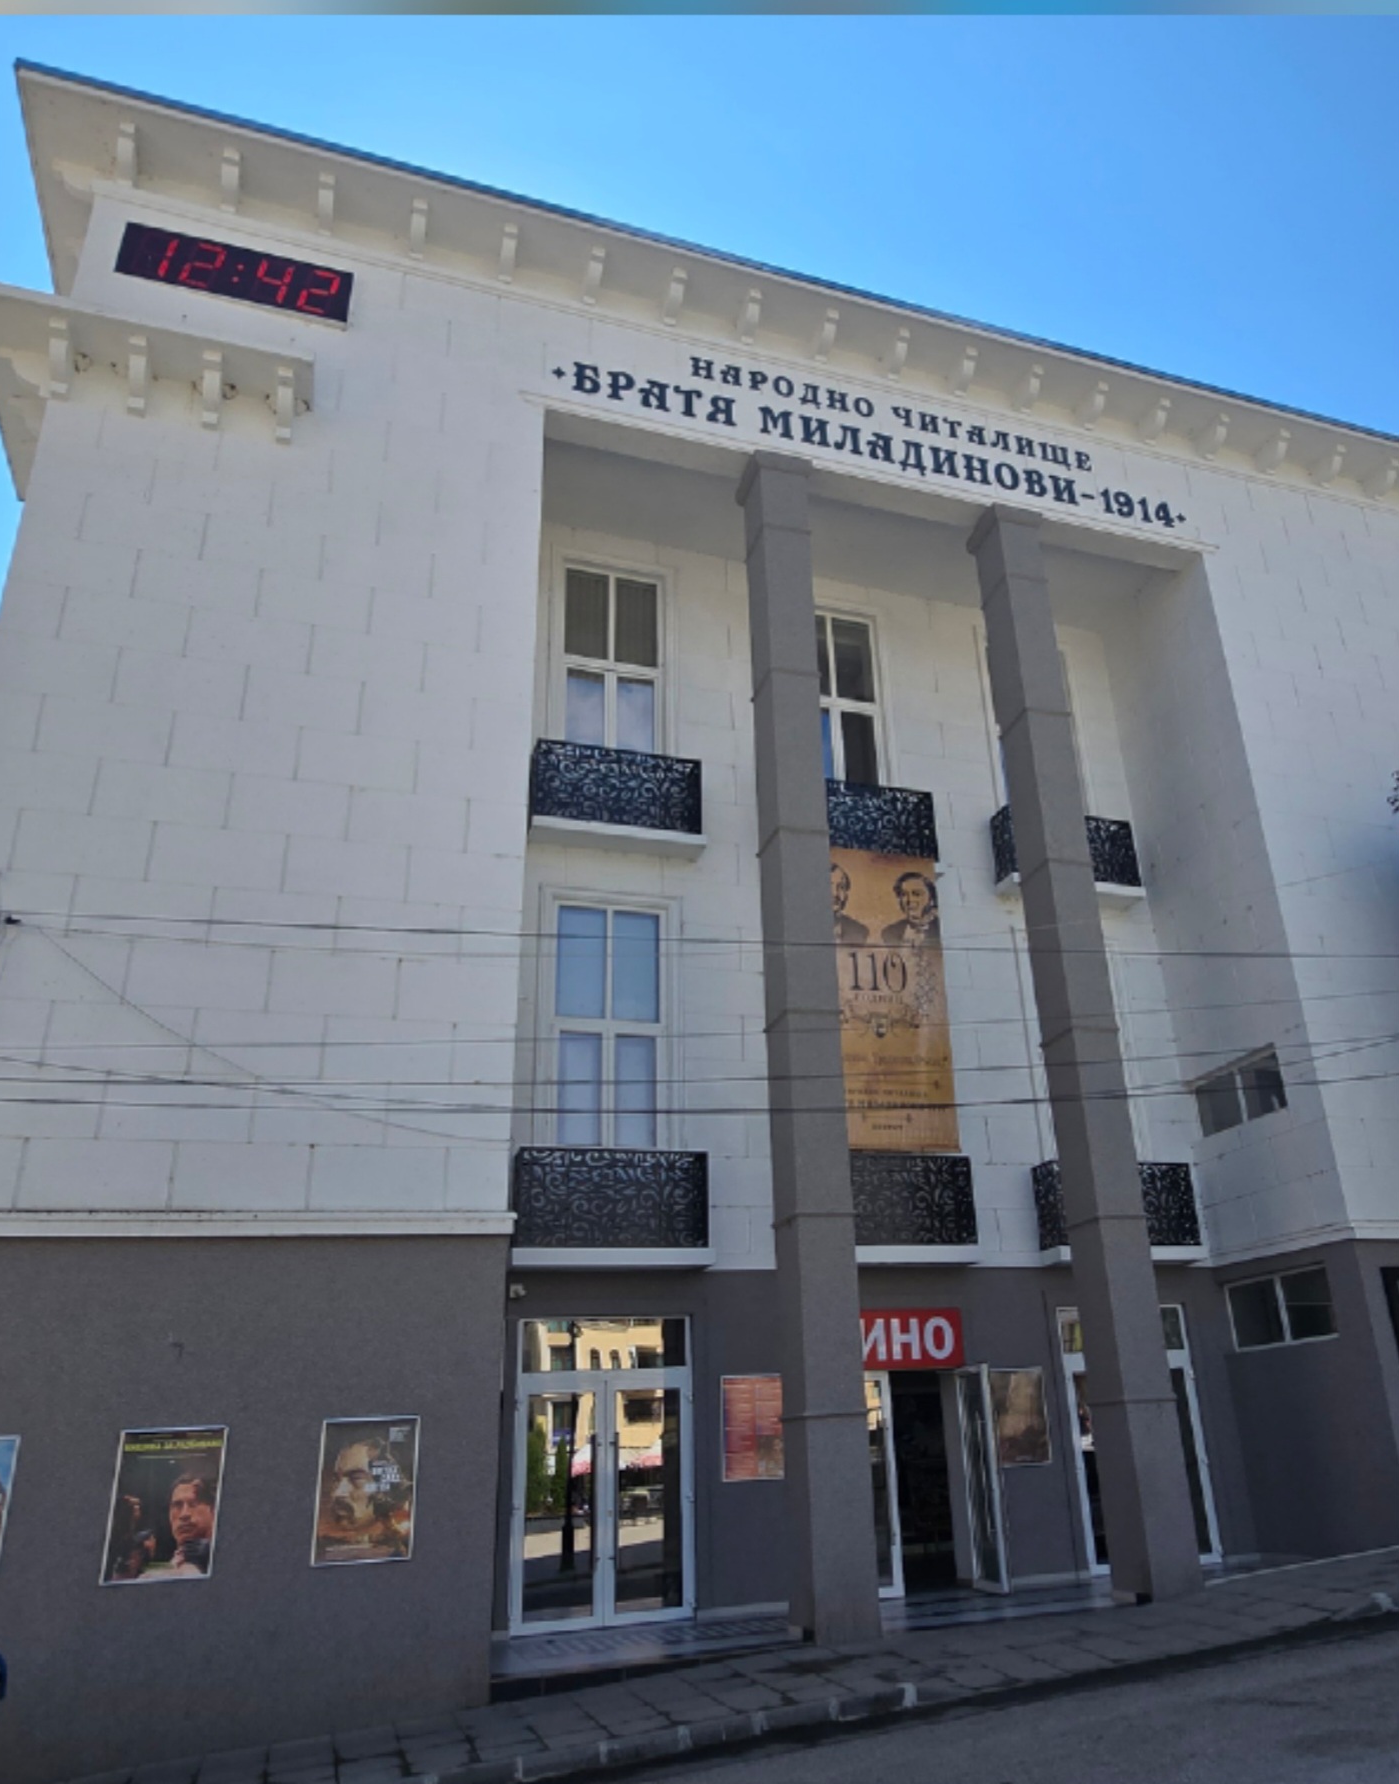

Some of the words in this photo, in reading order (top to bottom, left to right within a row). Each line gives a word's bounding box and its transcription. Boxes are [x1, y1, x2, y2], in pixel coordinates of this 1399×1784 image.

[157, 238, 342, 315] 12:42
[571, 361, 738, 427] БРАТЯ
[689, 356, 875, 418] НАРОДНО
[890, 405, 1093, 472] ЧИТАЛИЩЕ
[847, 950, 907, 993] 110
